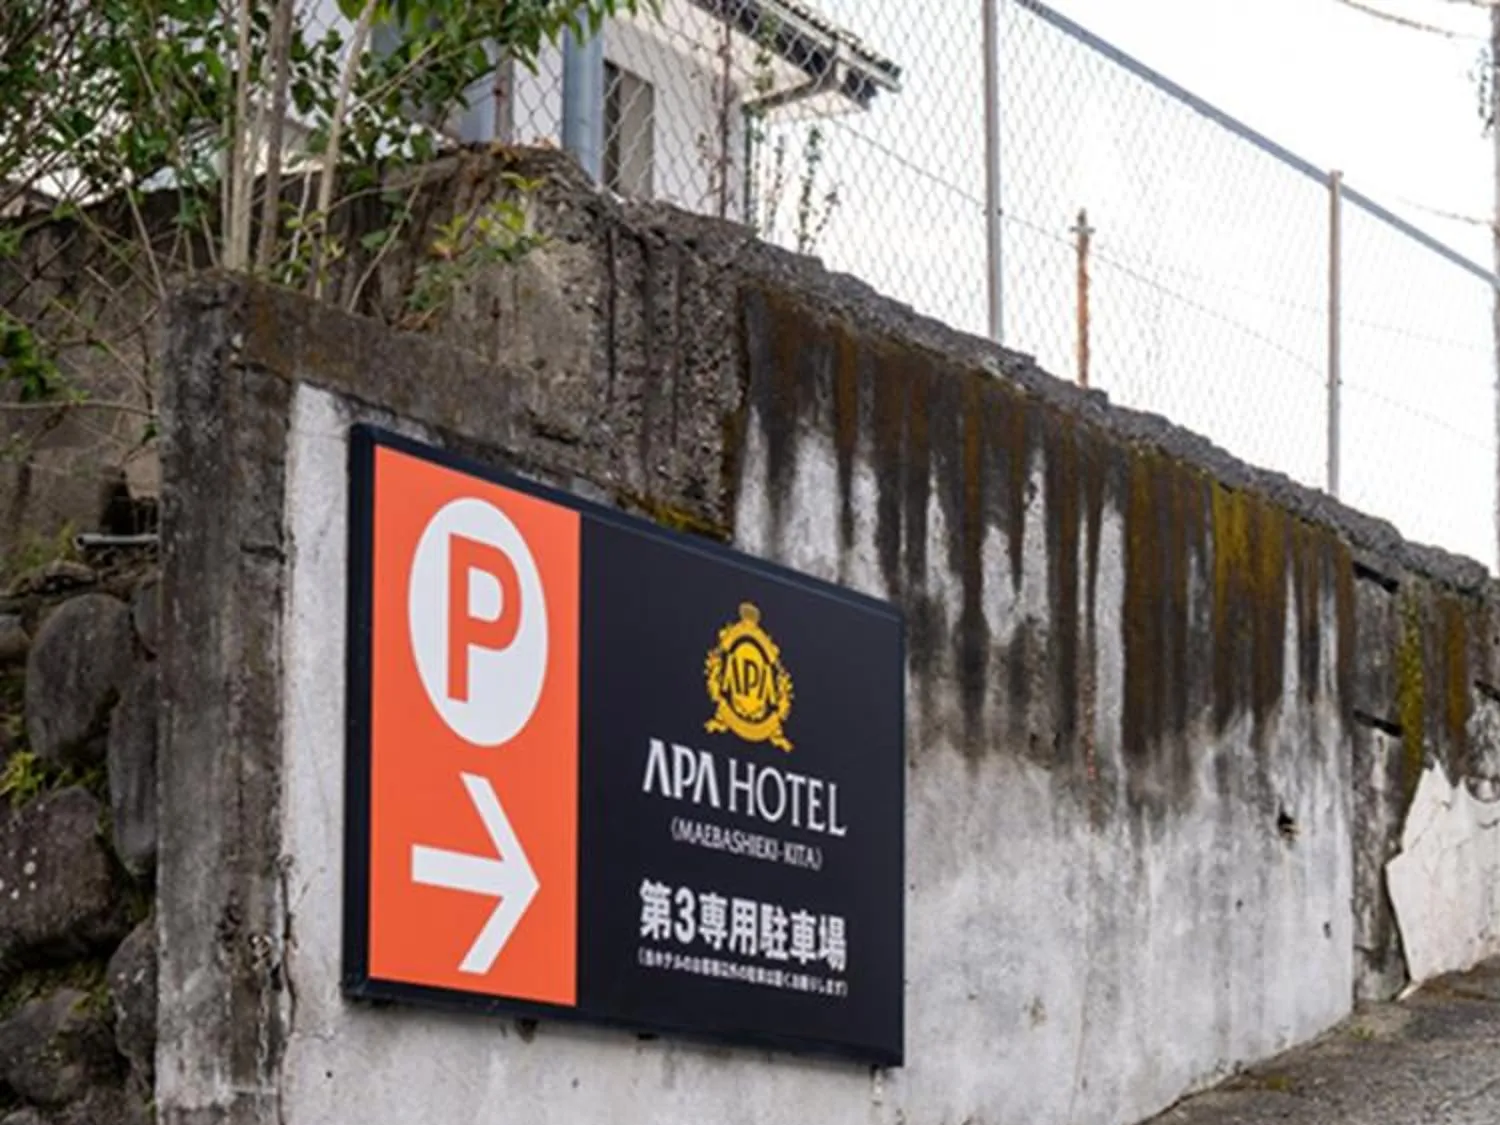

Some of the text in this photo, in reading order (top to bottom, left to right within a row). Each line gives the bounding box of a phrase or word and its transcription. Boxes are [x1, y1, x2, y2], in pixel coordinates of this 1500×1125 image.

[447, 531, 522, 704] P
[642, 737, 848, 837] APA HOTEL
[639, 878, 846, 973] 第3専用駐車場
